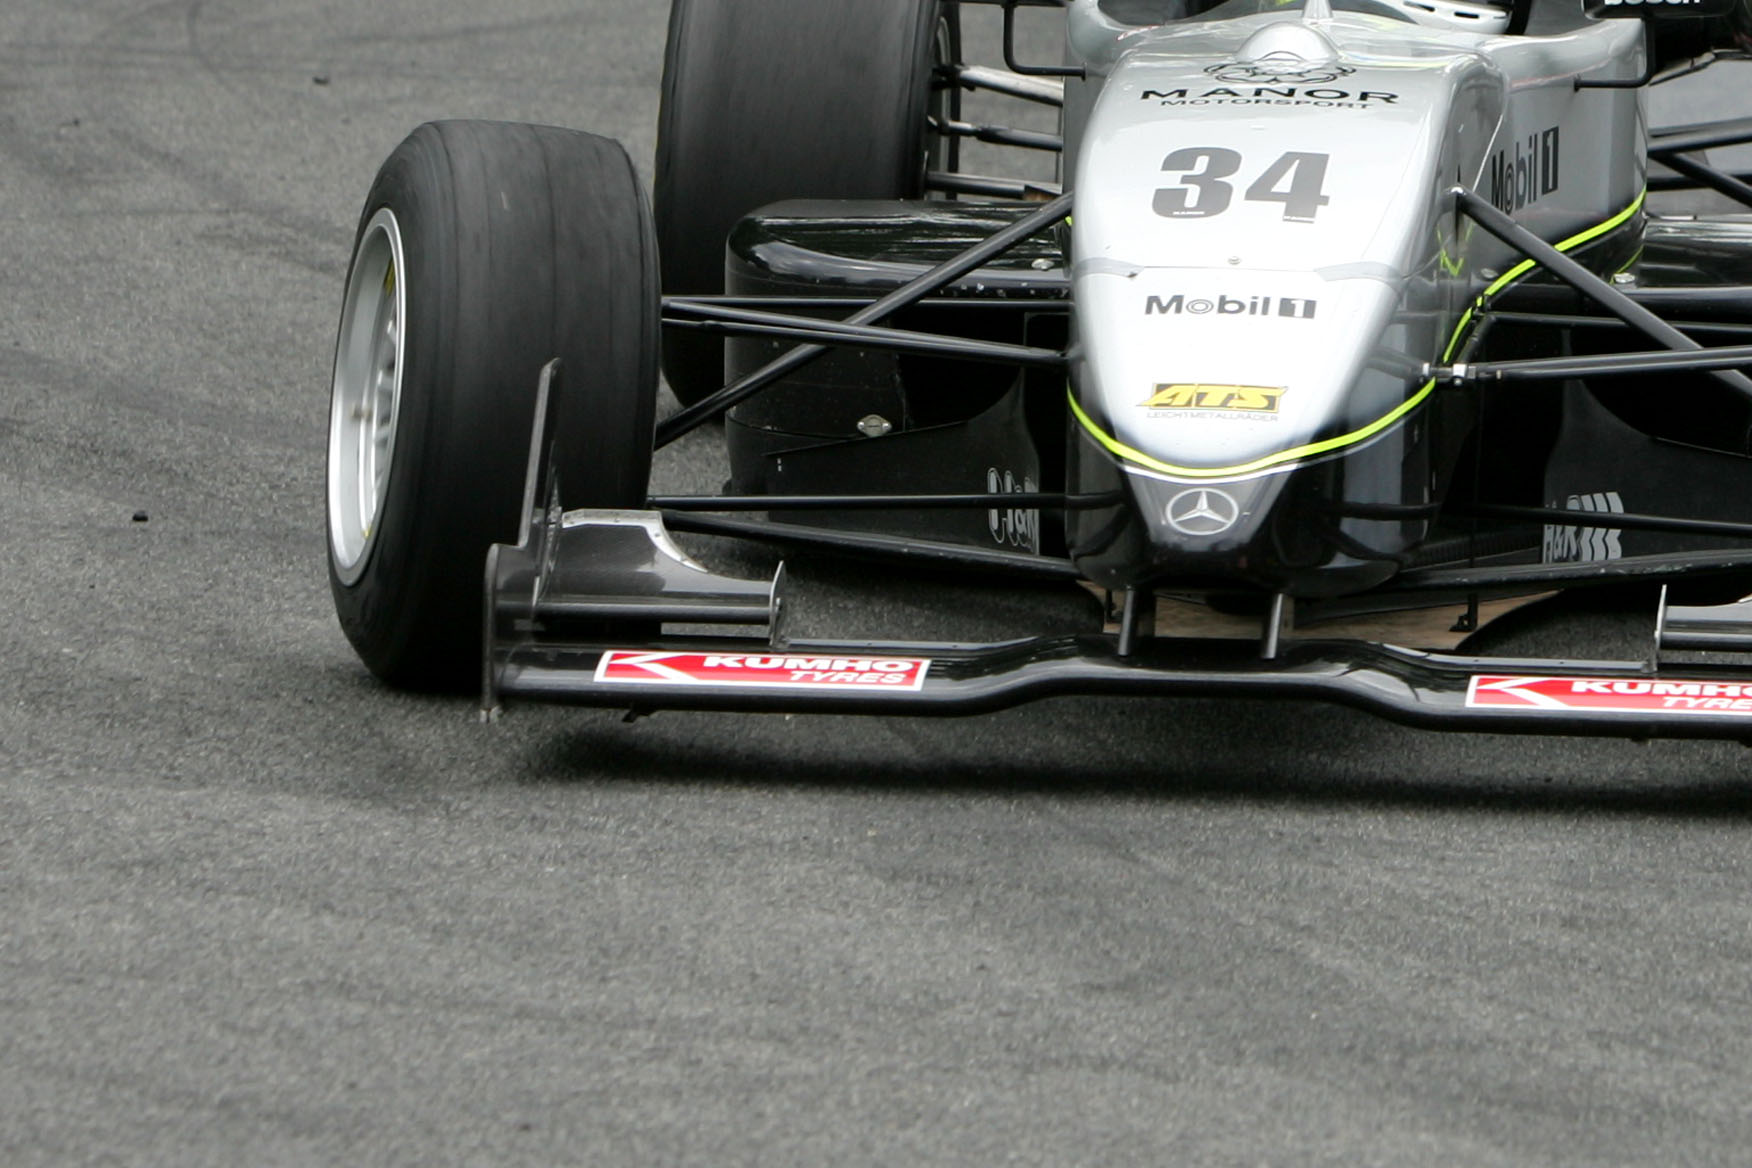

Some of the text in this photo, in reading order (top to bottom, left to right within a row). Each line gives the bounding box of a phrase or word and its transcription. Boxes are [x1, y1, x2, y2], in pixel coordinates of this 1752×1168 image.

[1140, 87, 1399, 104] MANOR
[1160, 99, 1376, 110] MOTORSPORT
[1491, 133, 1538, 216] Mobil
[1151, 146, 1331, 223] 34
[1144, 294, 1271, 316] Mobil
[1137, 383, 1288, 410] ATS
[702, 655, 915, 672] KUMHO
[788, 670, 907, 684] TYRES
